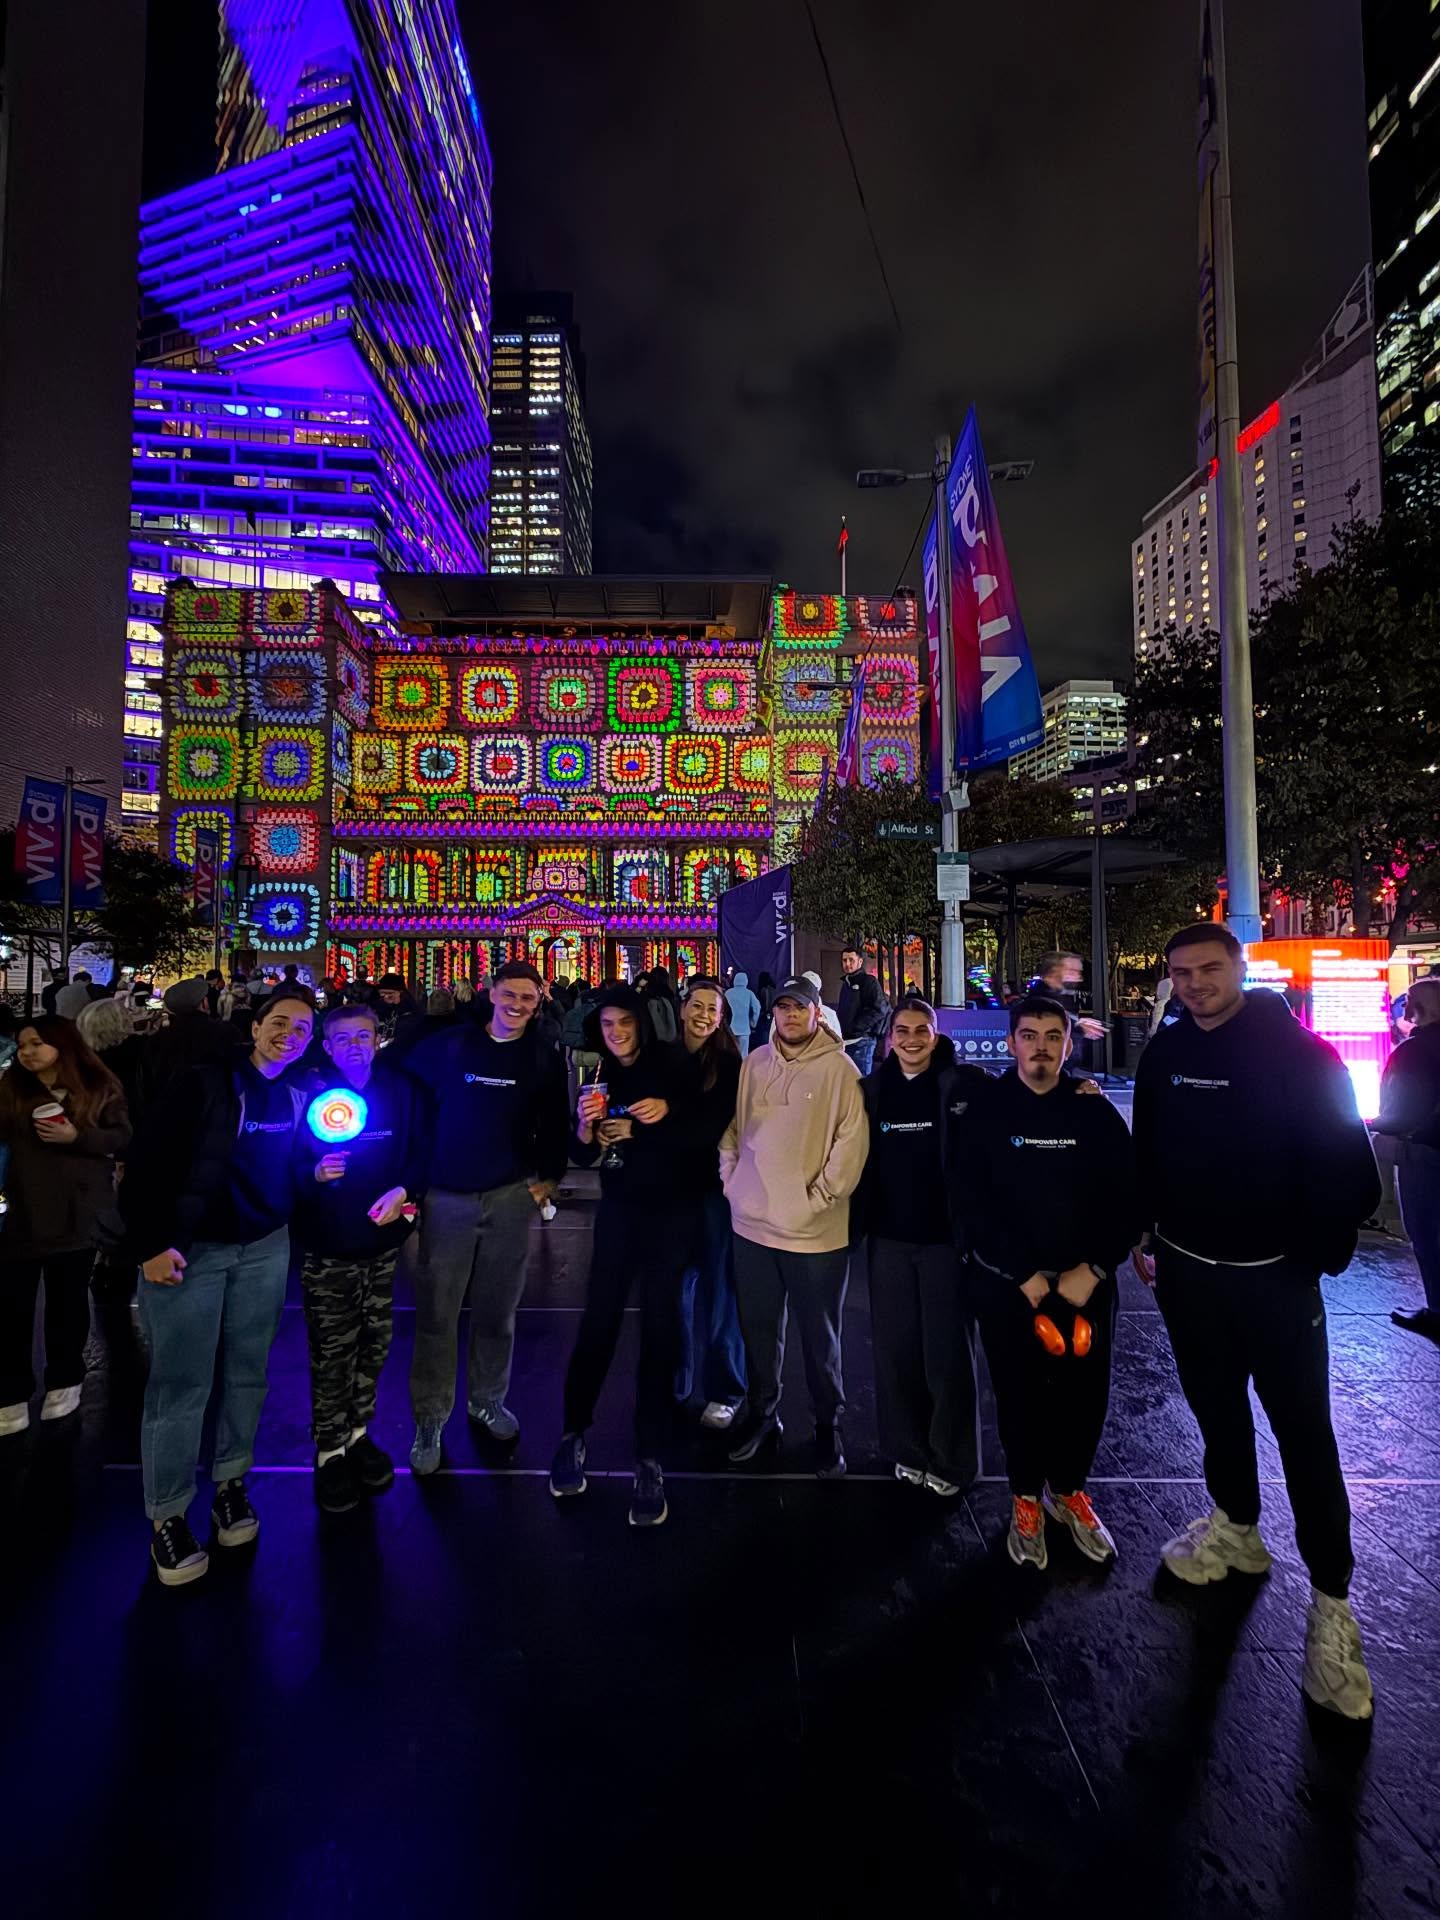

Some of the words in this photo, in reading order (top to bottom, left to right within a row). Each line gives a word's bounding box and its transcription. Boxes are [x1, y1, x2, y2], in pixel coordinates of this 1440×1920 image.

[890, 823, 918, 834] Alfred
[925, 825, 934, 835] St
[1058, 1138, 1077, 1146] CARE
